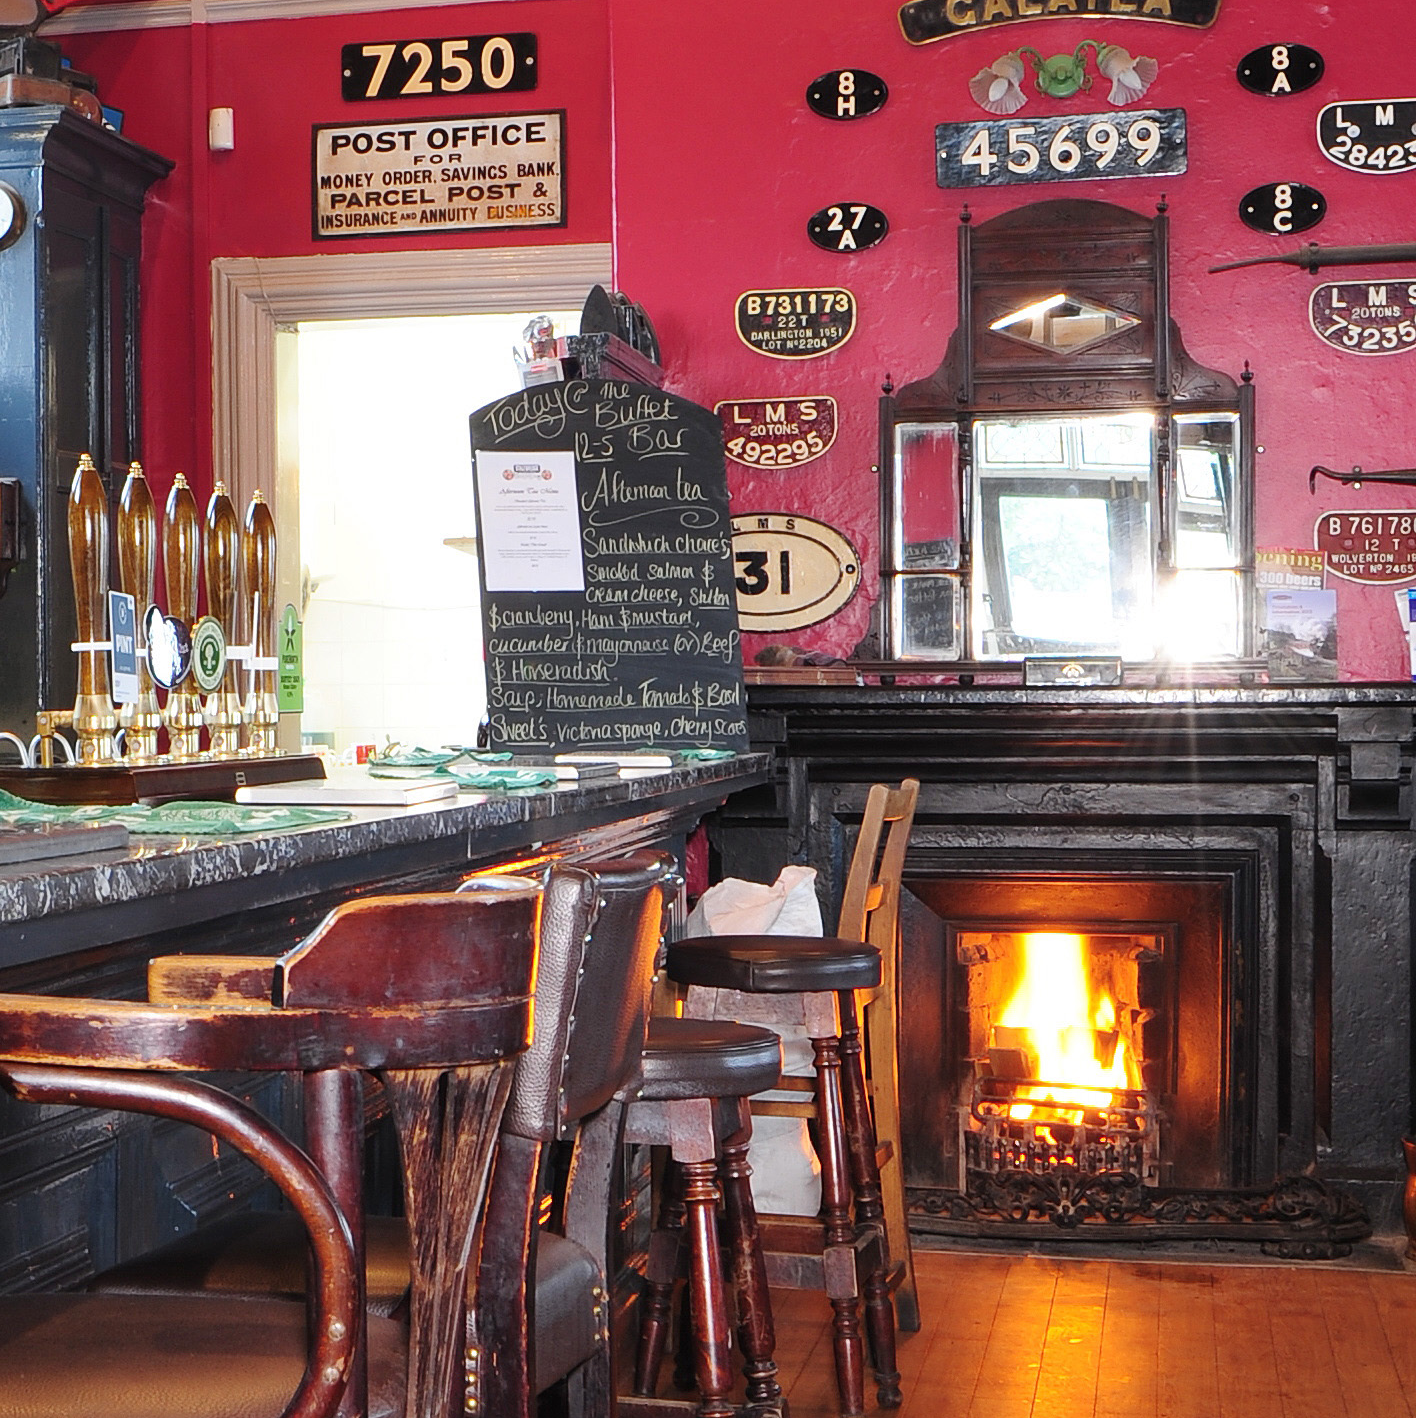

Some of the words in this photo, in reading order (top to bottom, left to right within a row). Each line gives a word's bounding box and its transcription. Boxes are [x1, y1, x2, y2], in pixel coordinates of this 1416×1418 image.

[362, 36, 515, 98] 7250
[1271, 45, 1290, 70] 8
[838, 71, 855, 95] 8
[1271, 71, 1291, 93] A
[837, 95, 856, 117] H
[331, 130, 417, 157] POST
[426, 121, 546, 150] OFFICE
[961, 119, 1161, 176] 45699
[412, 152, 463, 166] FOR
[320, 172, 374, 191] MONEY
[440, 164, 508, 183] SAVINGS
[330, 188, 436, 210] PARCEL
[447, 182, 522, 203] POST
[532, 181, 549, 198] &
[1274, 184, 1293, 209] 8
[320, 211, 398, 230] INSURANCE
[400, 212, 417, 222] AND
[419, 206, 478, 224] ANNUITY
[486, 202, 556, 221] BUSINESS
[827, 206, 868, 231] 27
[1273, 210, 1293, 232] C
[837, 229, 857, 250] A
[777, 315, 797, 327] 22
[750, 328, 813, 341] DARLINGTON
[819, 327, 843, 338] 1951
[762, 340, 782, 350] LOT
[483, 386, 566, 436] Today
[595, 394, 679, 428] Buffet
[627, 423, 690, 454] Bar
[727, 430, 824, 465] 492295
[677, 466, 708, 501] tea
[1365, 538, 1380, 551] 12
[1331, 553, 1394, 564] WOLVERTON
[1343, 564, 1365, 575] LOT
[646, 562, 695, 580] salmon
[1259, 571, 1284, 584] 300
[1284, 573, 1322, 587] beers
[581, 608, 615, 629] Ham
[115, 633, 133, 654] PINT
[488, 633, 568, 654] cucumber
[700, 629, 741, 664] Beef
[547, 686, 636, 709] Homemade
[638, 677, 691, 707] Tomato
[707, 682, 740, 707] Basil
